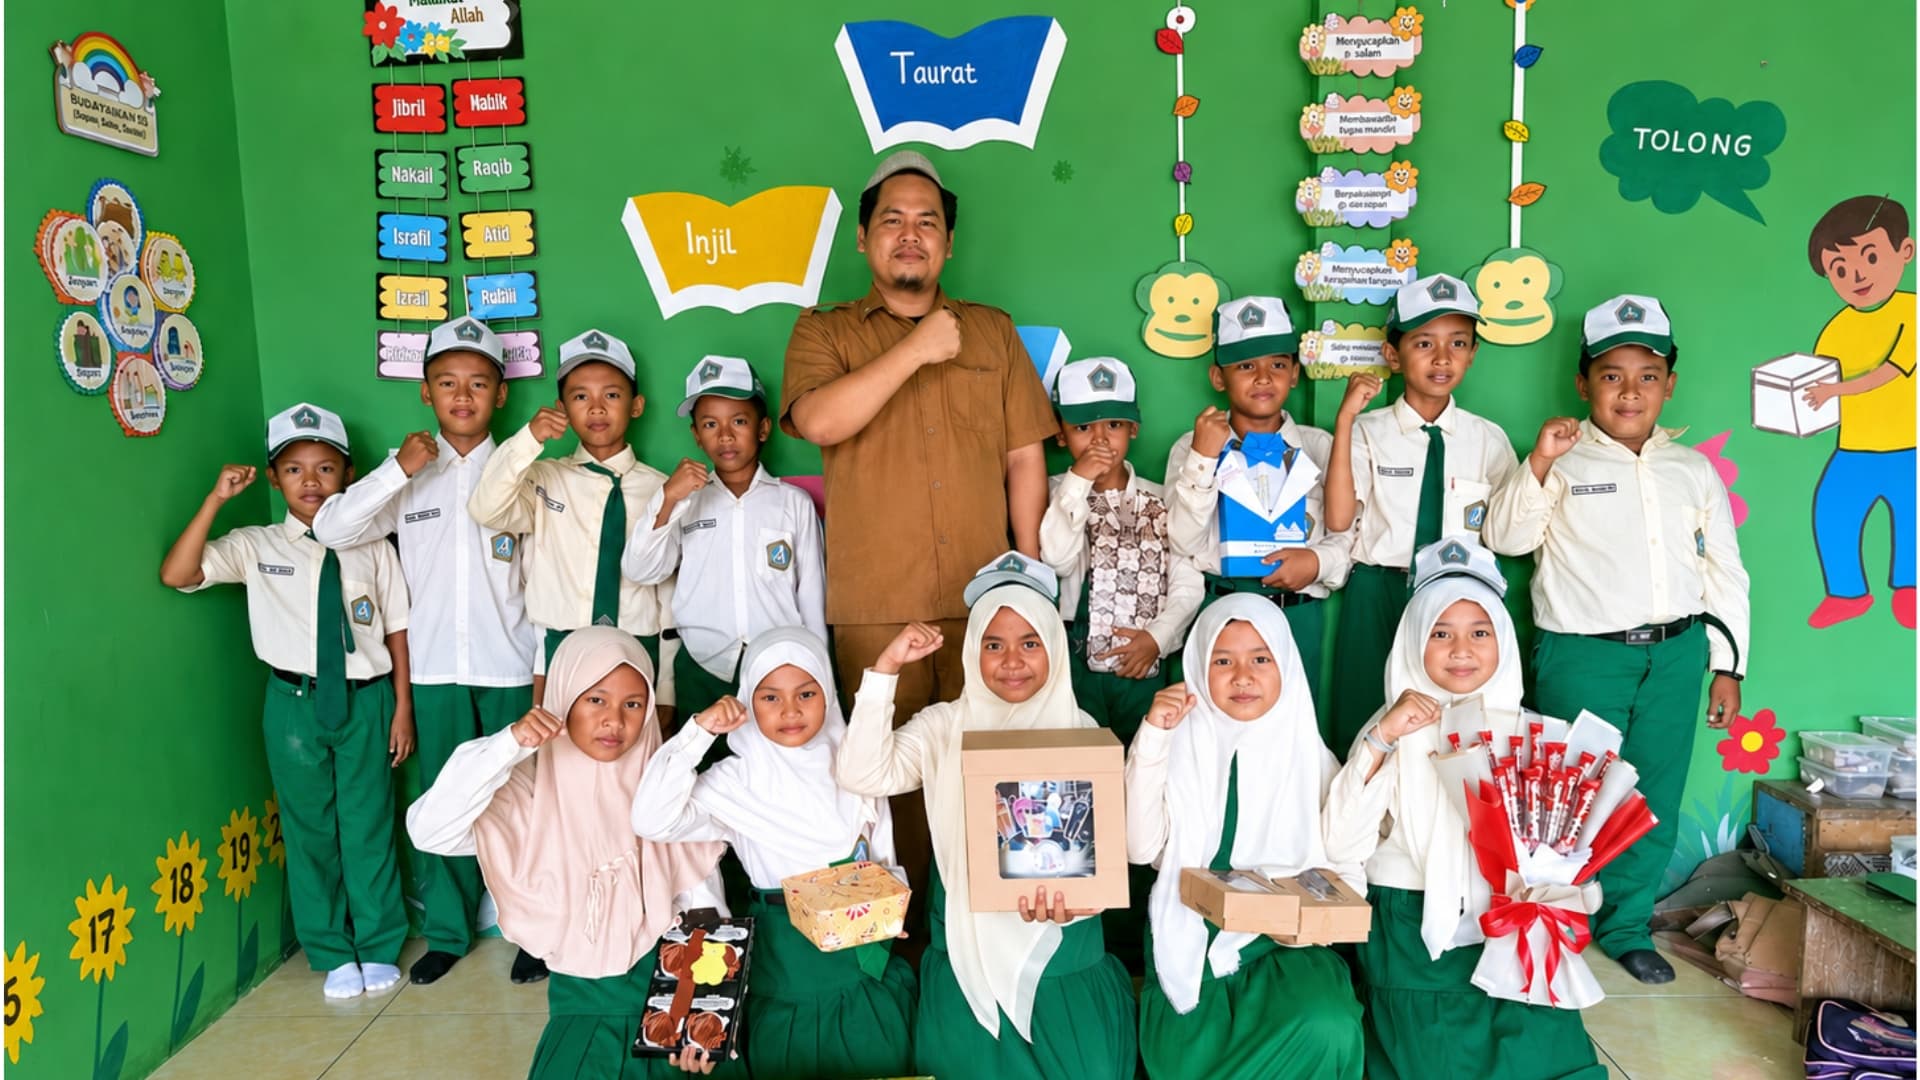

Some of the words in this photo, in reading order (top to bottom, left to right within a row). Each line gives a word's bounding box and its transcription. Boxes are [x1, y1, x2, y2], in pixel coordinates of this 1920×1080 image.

[450, 6, 484, 24] Allah
[889, 51, 978, 85] Taurat
[392, 98, 426, 119] Jibril
[1633, 127, 1753, 157] TOLONG
[473, 157, 512, 178] Raqib
[393, 227, 431, 247] Israfil
[685, 221, 737, 265] Injil
[396, 289, 429, 307] Izrail
[229, 831, 251, 873] 19
[170, 862, 195, 905] 18
[88, 907, 116, 955] 17
